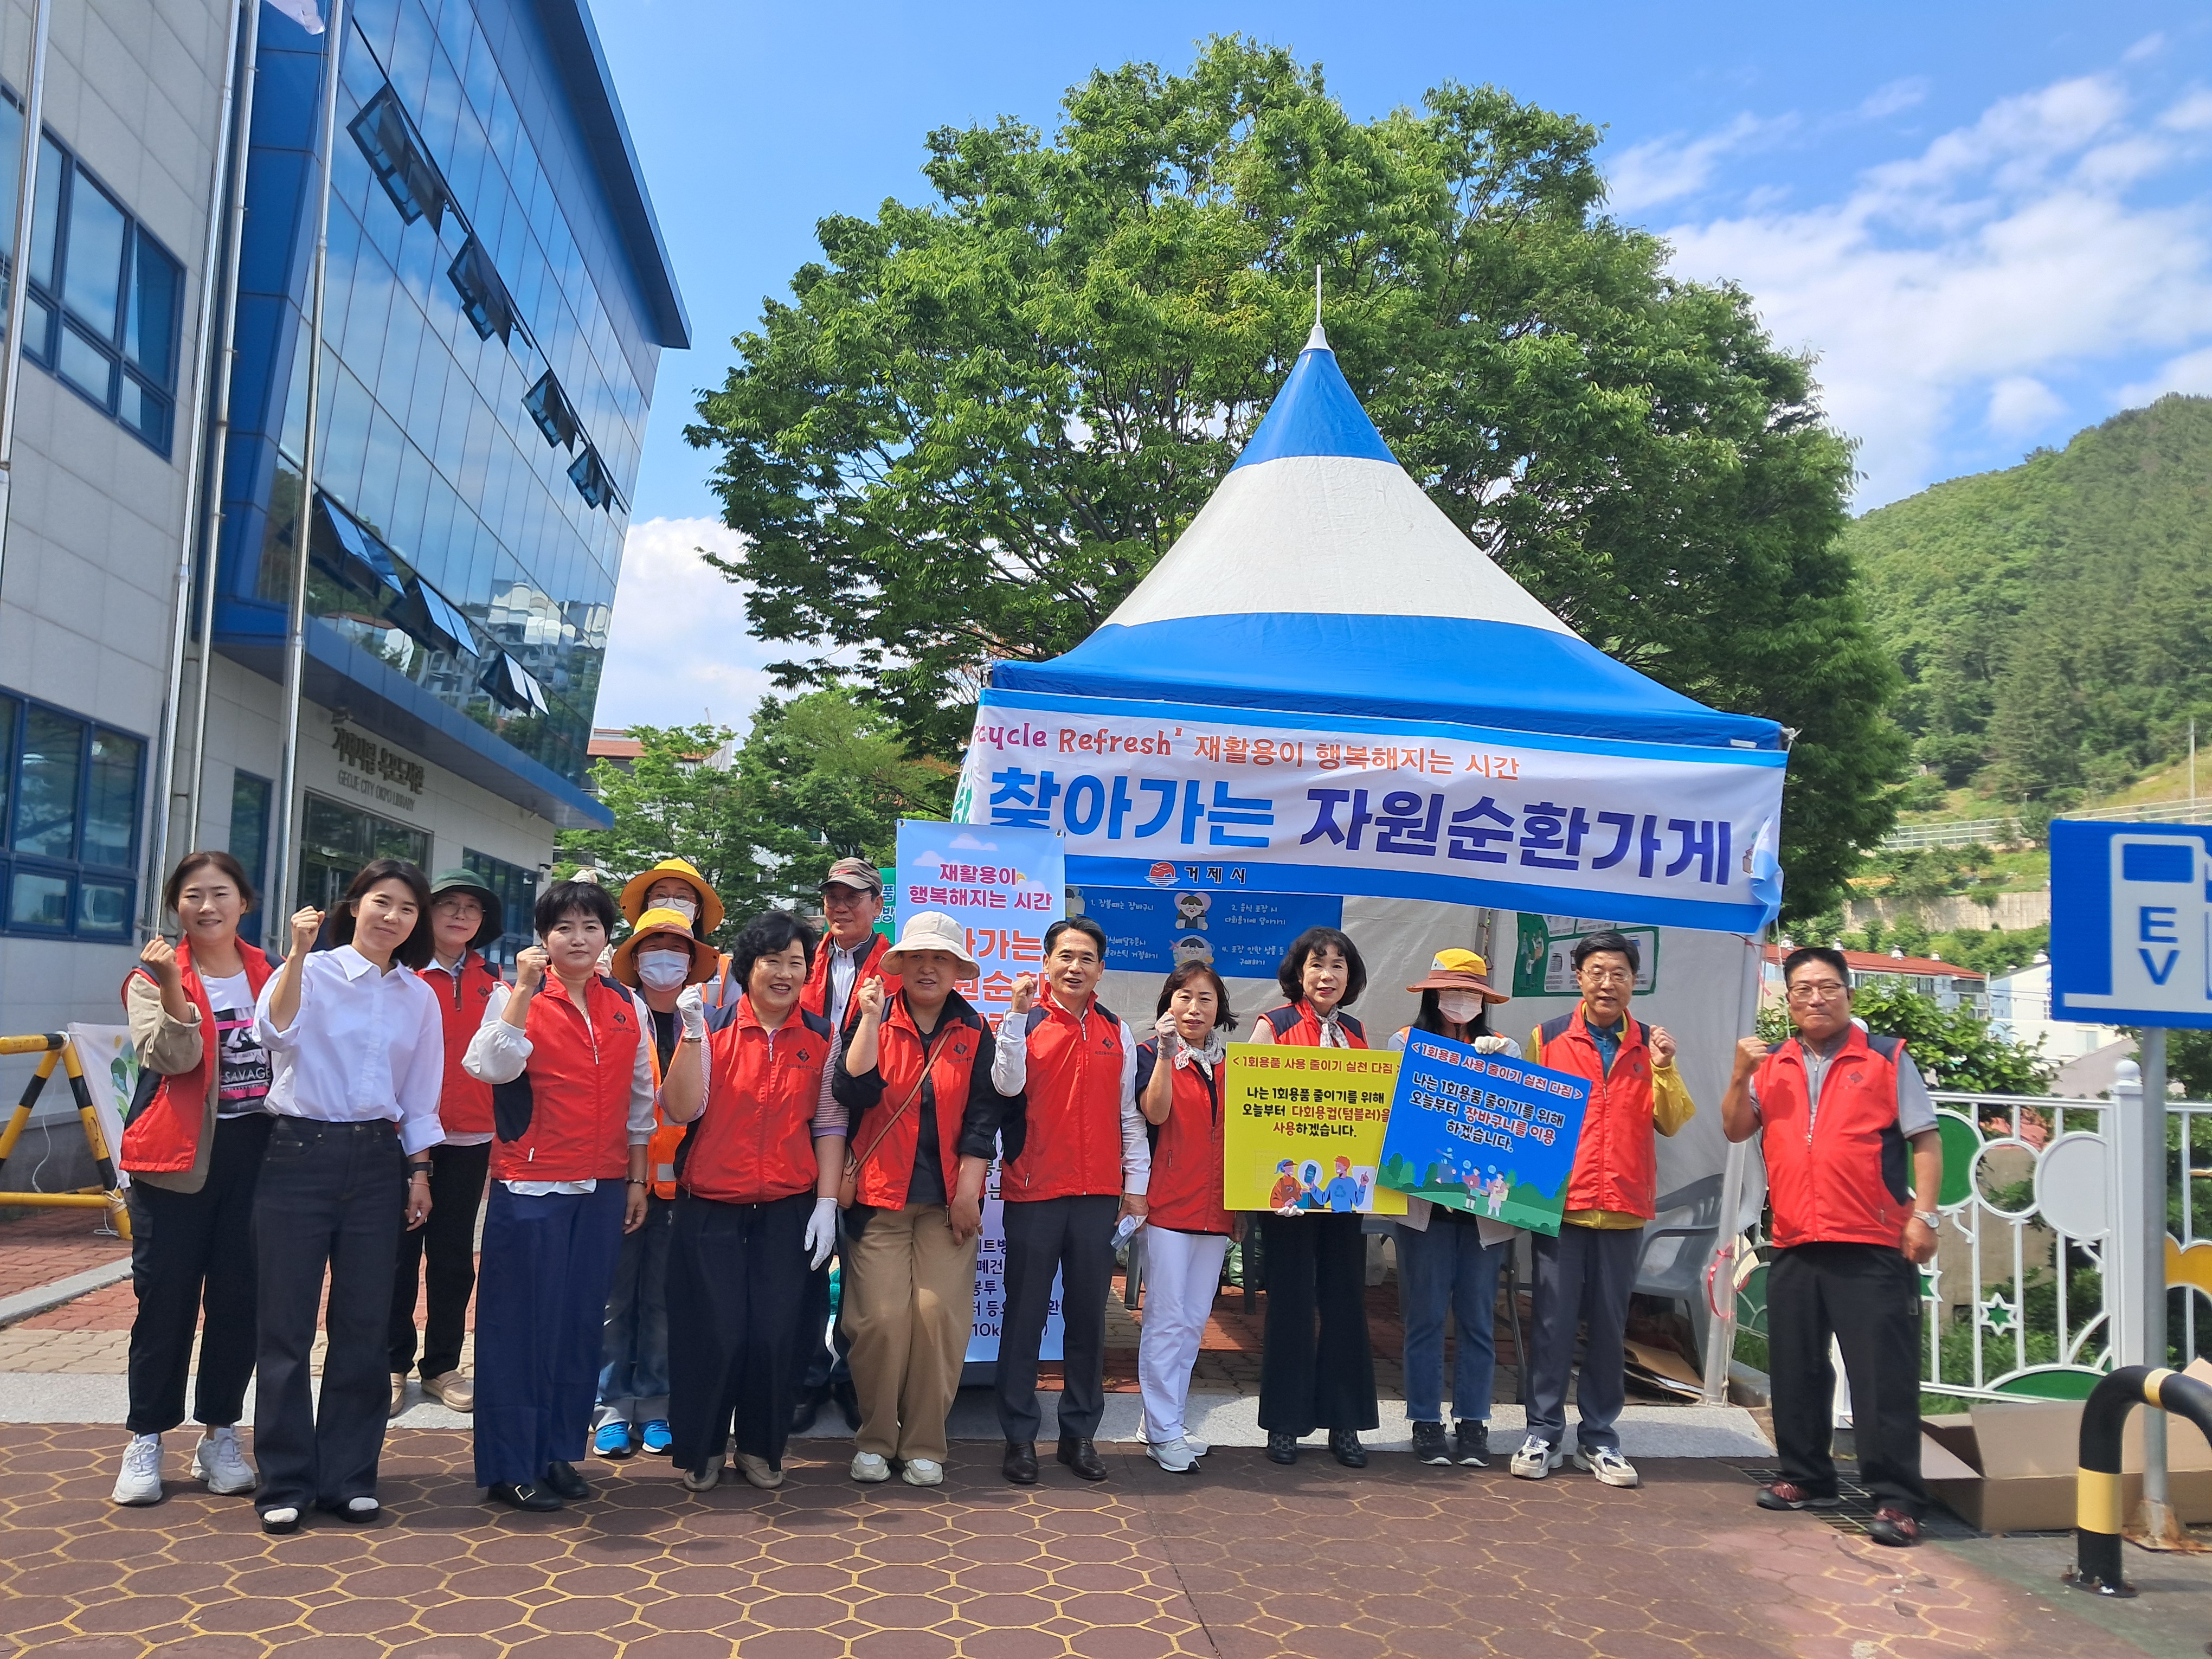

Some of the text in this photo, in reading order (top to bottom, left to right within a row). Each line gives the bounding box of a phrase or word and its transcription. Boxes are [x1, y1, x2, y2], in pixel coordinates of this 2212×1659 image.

[1193, 735, 1303, 768] 재활용이
[1315, 743, 1454, 774] 행복해지는
[1465, 754, 1520, 781] 시간
[338, 769, 360, 791] GEOJE
[361, 779, 375, 796] CITY
[393, 792, 415, 812] LIBRARY
[989, 767, 1733, 886] 찾아가는 자원순환가게
[940, 864, 1017, 885] 재활용이
[909, 885, 1052, 910] 행복해지는 시간
[1128, 902, 1154, 911] 장바구니
[1240, 903, 1252, 912] 음식
[1255, 904, 1268, 913] 포장
[1225, 915, 1256, 924] 다회용기에
[1131, 950, 1158, 960] 거절하기
[1232, 945, 1244, 954] 포장
[1264, 946, 1276, 955] 상품
[1243, 1056, 1281, 1069] 1회용품
[1284, 1058, 1306, 1070] 사용
[1310, 1059, 1342, 1072] 줄이기
[1346, 1062, 1367, 1073] 실천
[1372, 1063, 1393, 1074] 다짐
[1422, 1044, 1461, 1065] 1회용품
[1463, 1057, 1485, 1072] 사용
[1487, 1063, 1522, 1082] 줄이기
[1524, 1074, 1547, 1090] 실천
[1549, 1082, 1573, 1098] 다짐
[1247, 1086, 1384, 1104] 나는 1회용품 줄이기를 위해
[1412, 1072, 1565, 1127] 나는 1회용품 줄이기를 위해
[1242, 1103, 1285, 1117] 오늘부터
[1410, 1090, 1555, 1145] 오늘부터 장바구니를 이용
[1273, 1122, 1356, 1137] 사용하겠습니다.
[1446, 1120, 1514, 1153] 하겠습니다.
